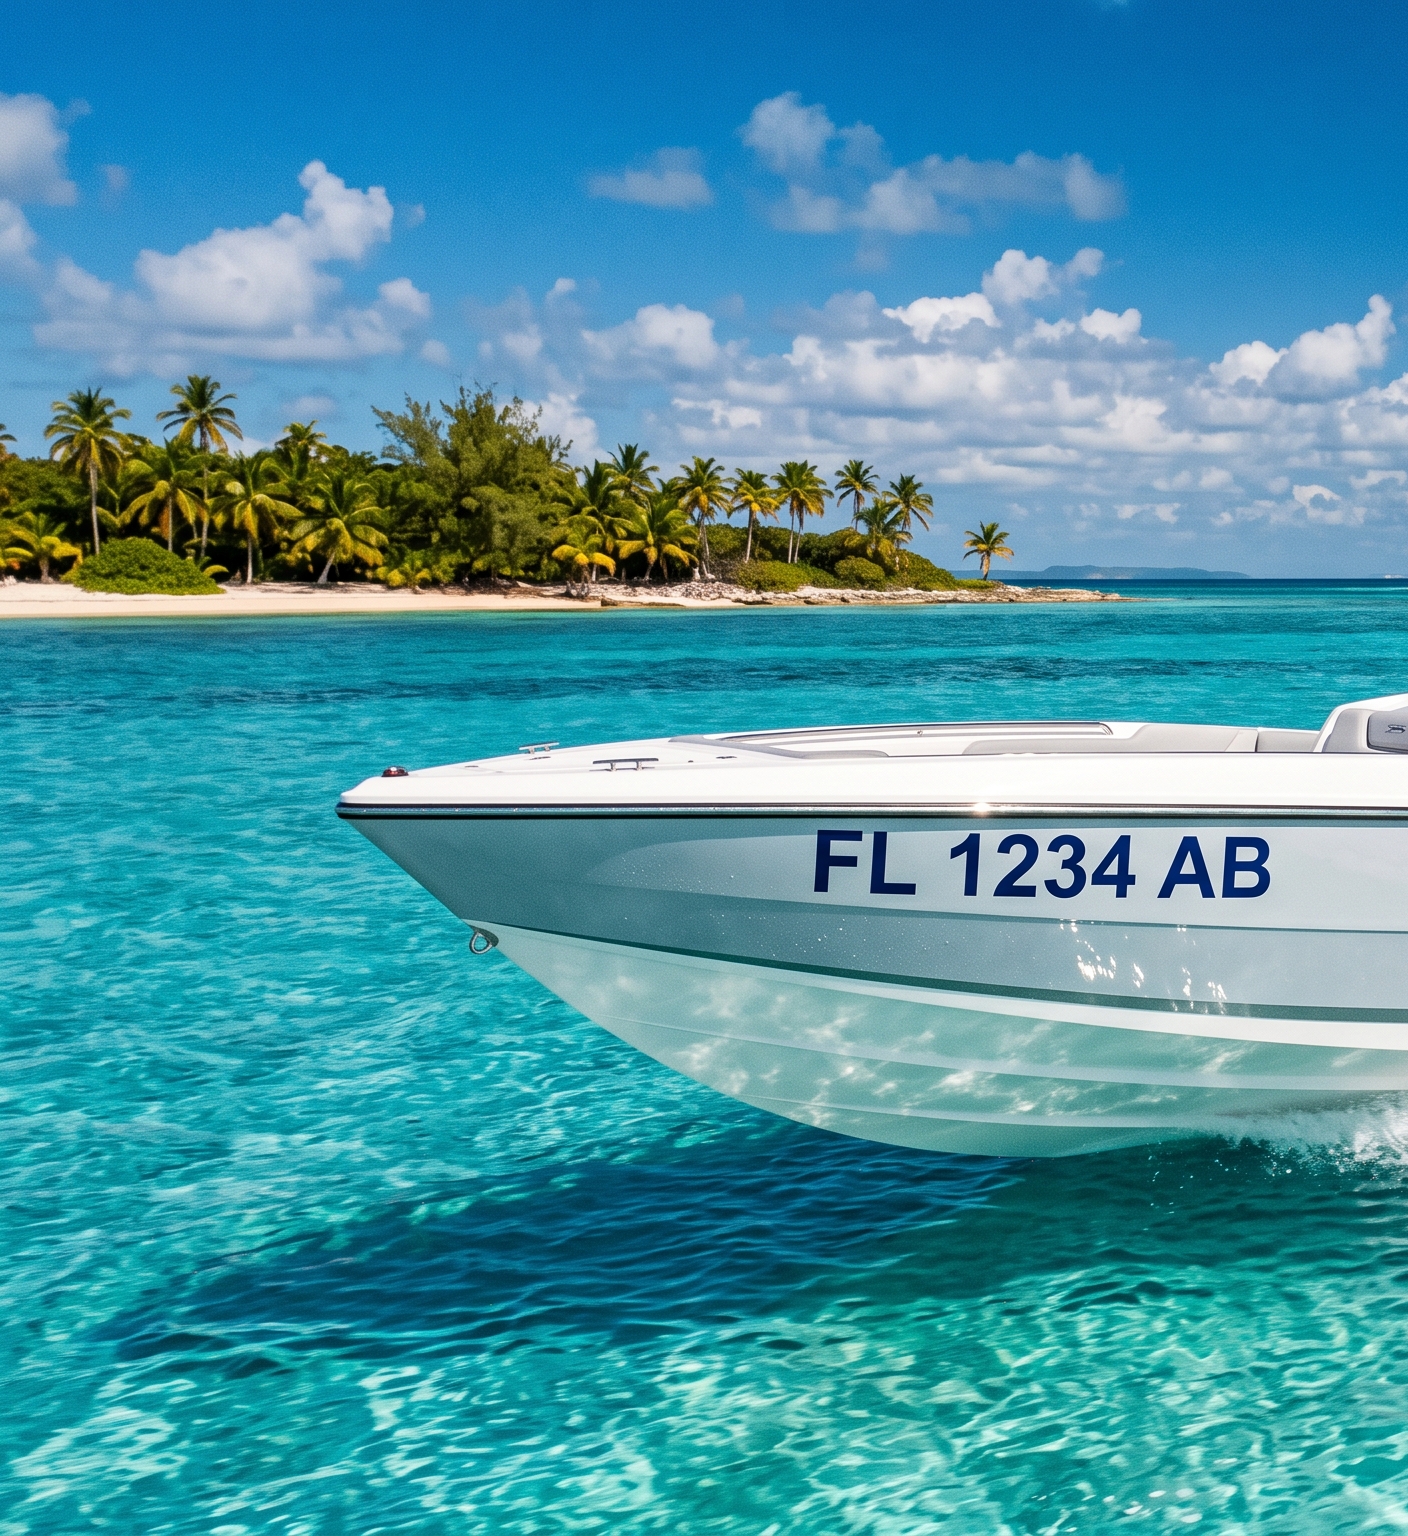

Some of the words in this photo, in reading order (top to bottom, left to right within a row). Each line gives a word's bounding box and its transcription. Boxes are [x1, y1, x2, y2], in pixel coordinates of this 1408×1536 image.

[813, 829, 917, 896] FL
[949, 833, 1136, 899] 1234
[1157, 836, 1271, 899] AB
